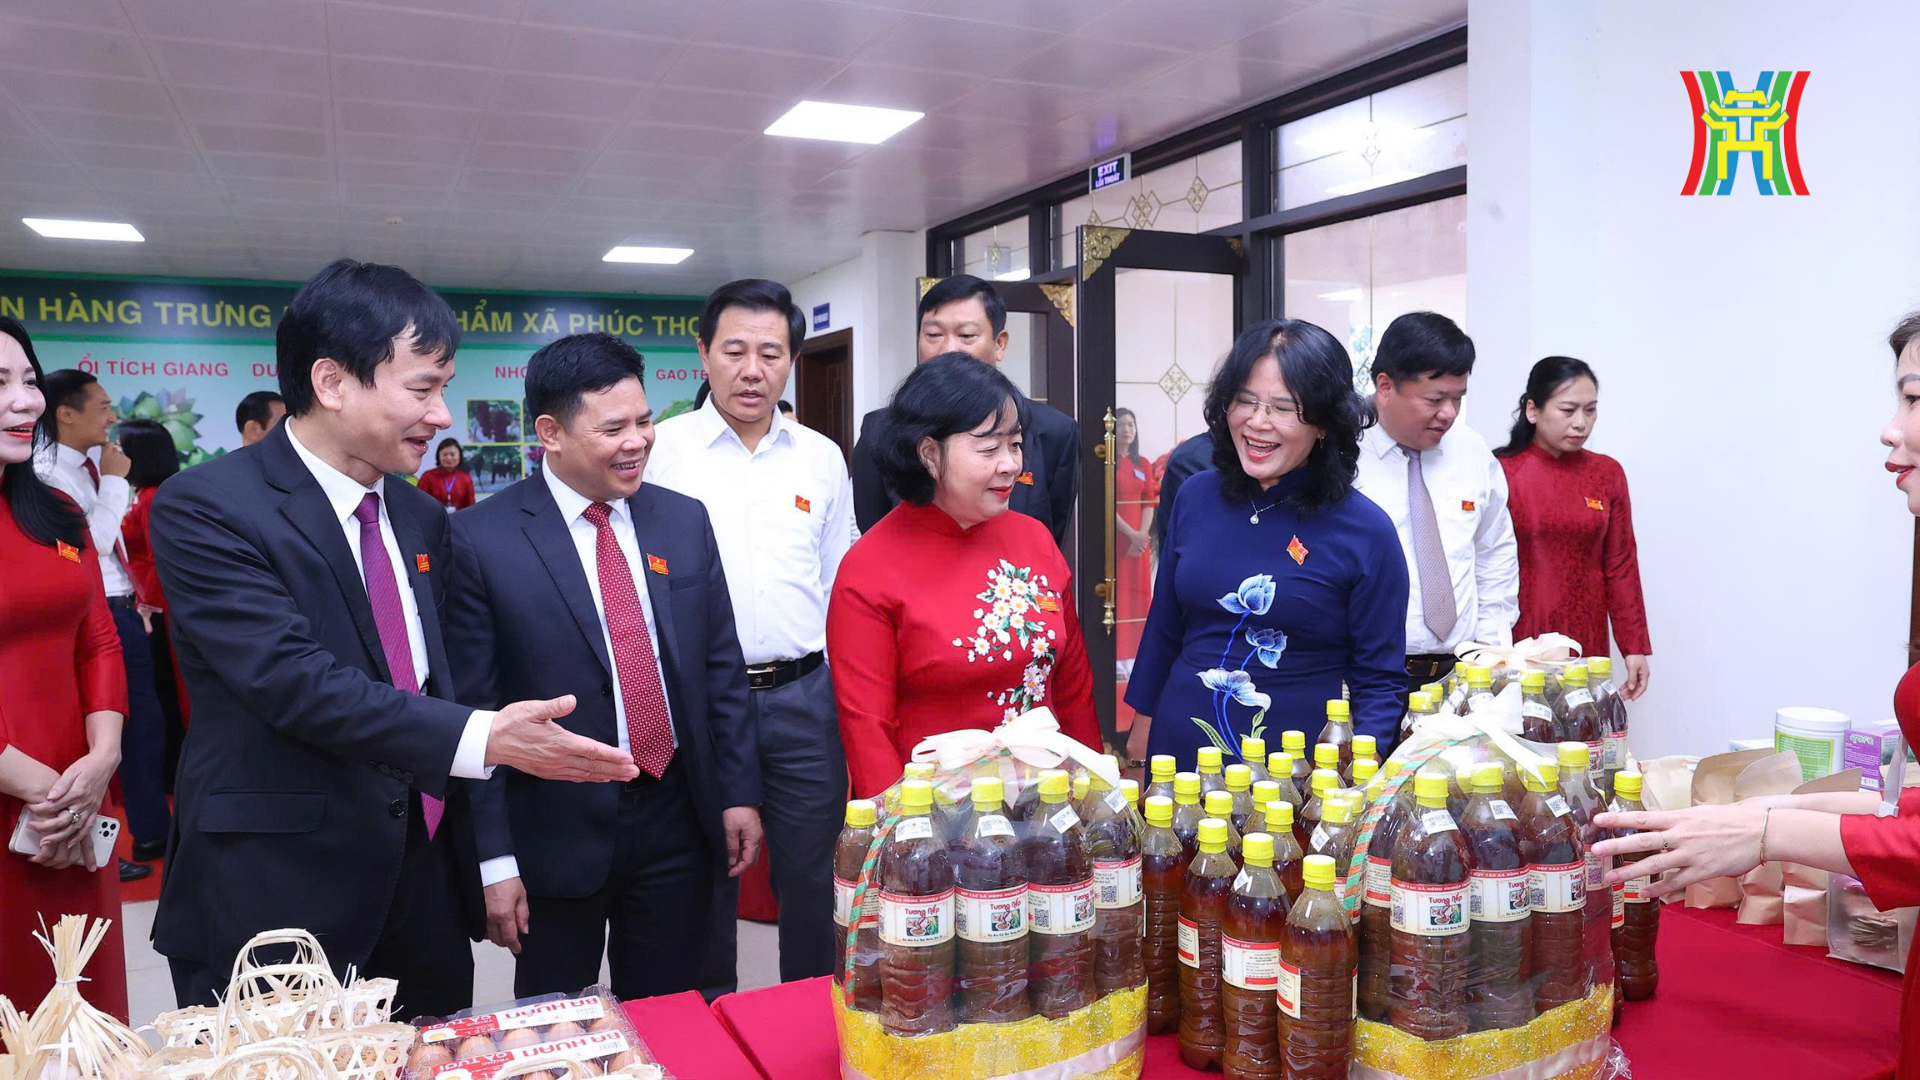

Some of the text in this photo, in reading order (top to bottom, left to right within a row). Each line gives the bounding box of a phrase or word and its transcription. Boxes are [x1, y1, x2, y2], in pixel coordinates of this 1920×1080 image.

[1098, 161, 1118, 177] EXIT
[39, 292, 142, 324] HÀNG
[153, 300, 272, 328] TRƯNG
[453, 299, 513, 333] HẨM
[522, 308, 560, 333] XÃ
[569, 309, 643, 336] PHÚC
[78, 352, 228, 377] ỔI TÍCH GIANG
[570, 997, 599, 1007] BA
[591, 1032, 621, 1043] BA
